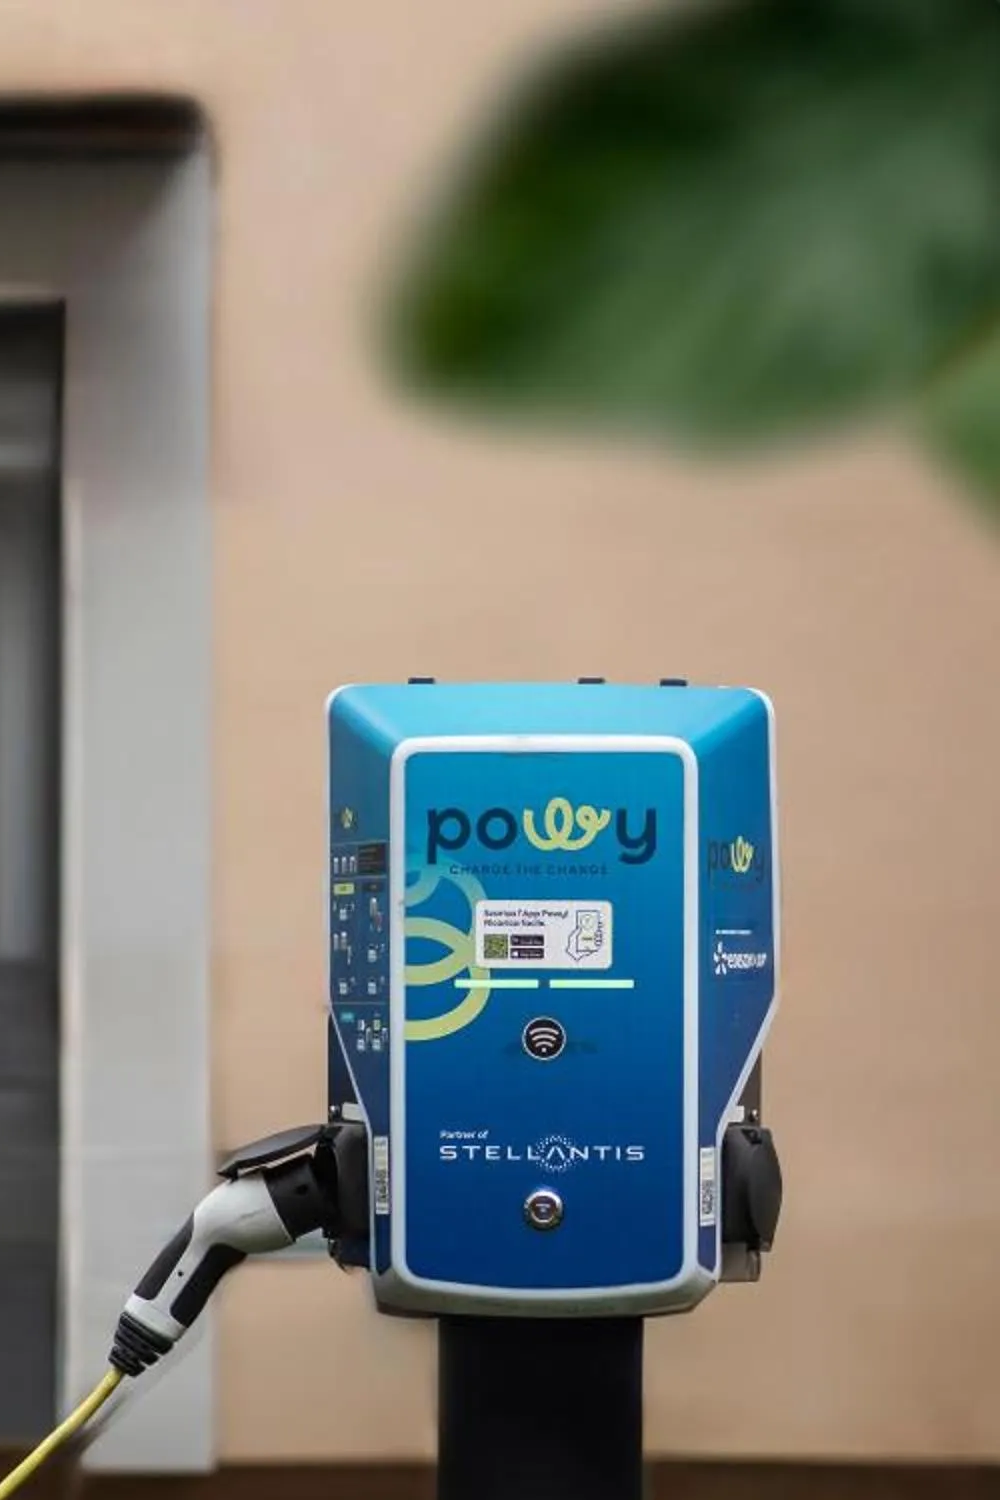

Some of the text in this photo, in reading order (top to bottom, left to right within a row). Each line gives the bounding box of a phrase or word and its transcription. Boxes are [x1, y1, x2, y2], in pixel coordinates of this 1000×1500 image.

[450, 863, 607, 875] CHARGE THE CHANGE
[440, 1129, 489, 1139] Partner of
[439, 1144, 645, 1161] STELLANTIS
